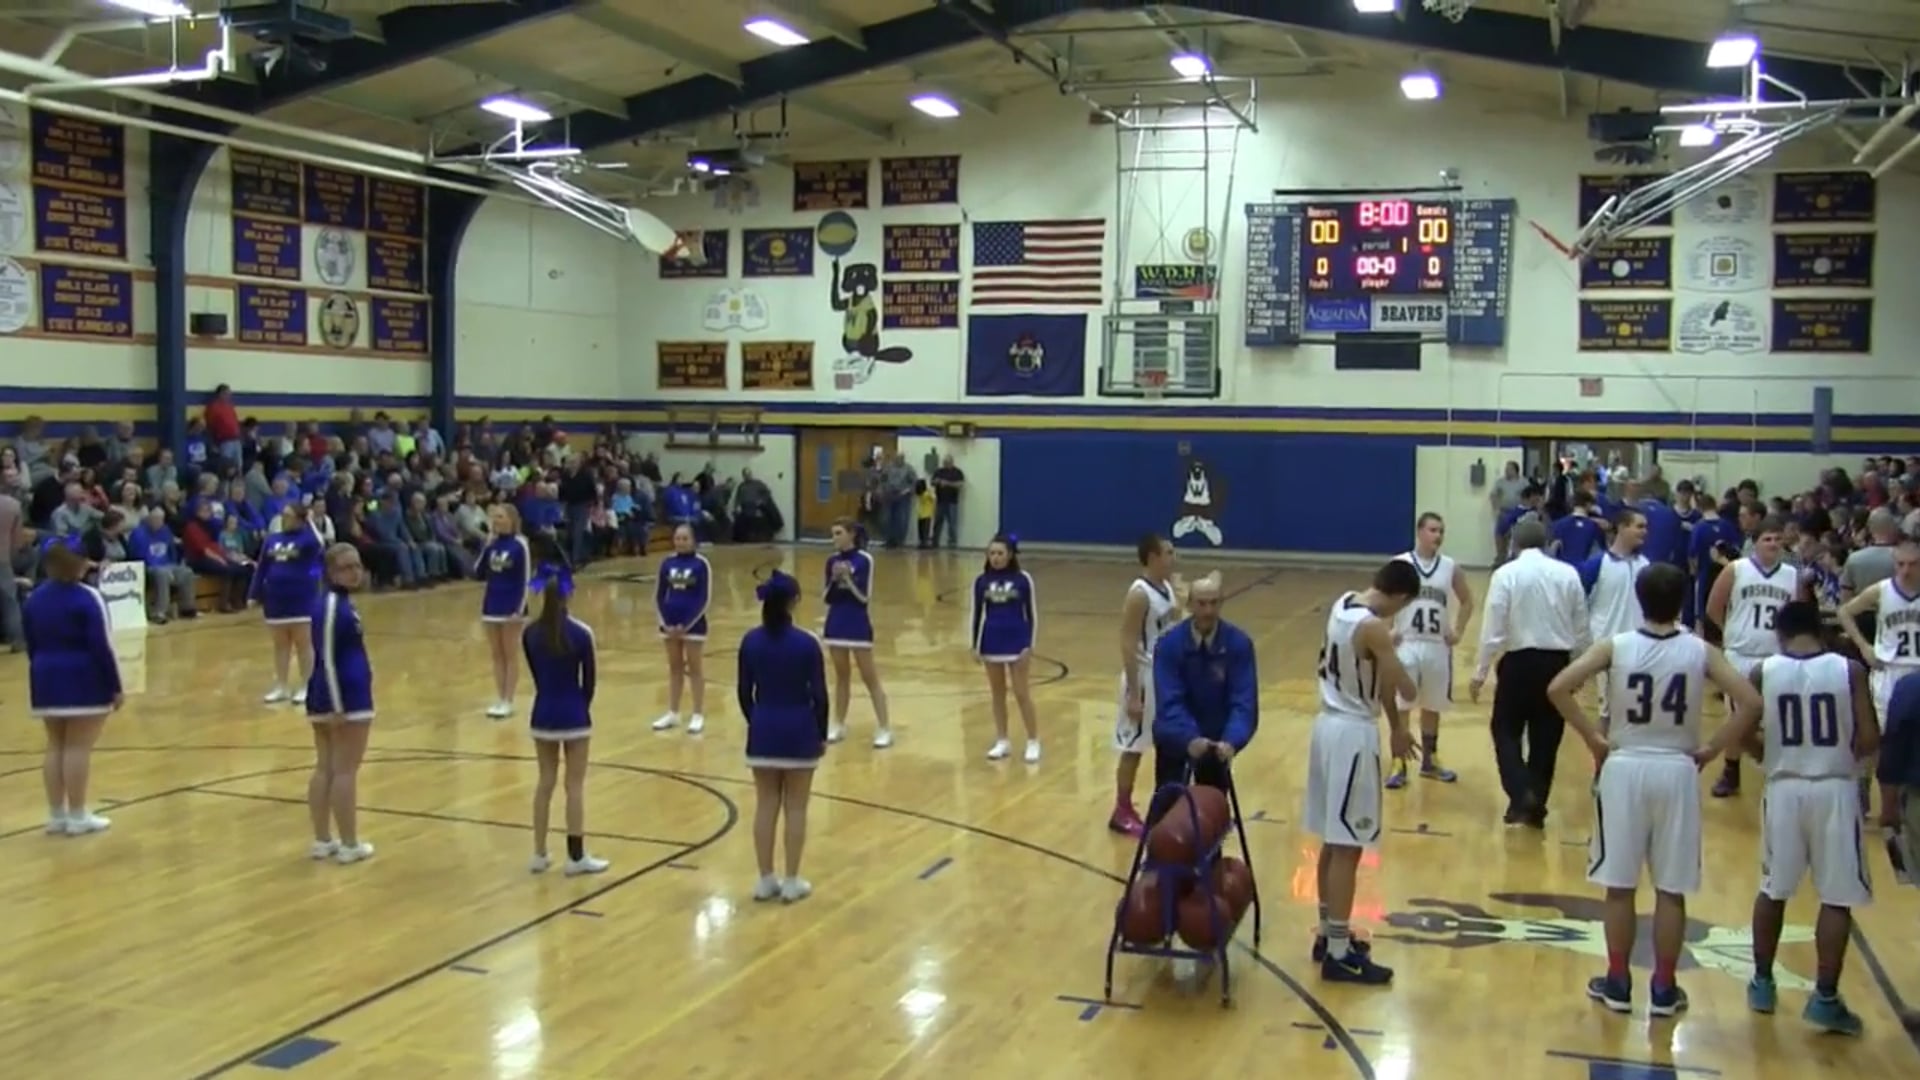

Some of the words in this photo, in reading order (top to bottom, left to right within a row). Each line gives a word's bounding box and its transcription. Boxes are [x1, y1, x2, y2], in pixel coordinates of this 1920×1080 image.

[1360, 202, 1409, 226] 8:00
[1311, 219, 1340, 243] 00
[1419, 219, 1448, 243] 00
[1316, 257, 1329, 275] 0
[1428, 256, 1441, 275] 0
[1381, 305, 1443, 322] BEAVERS
[1412, 608, 1441, 634] 45
[1753, 604, 1777, 631] 13
[1626, 672, 1687, 725] 34
[1778, 693, 1839, 747] 00
